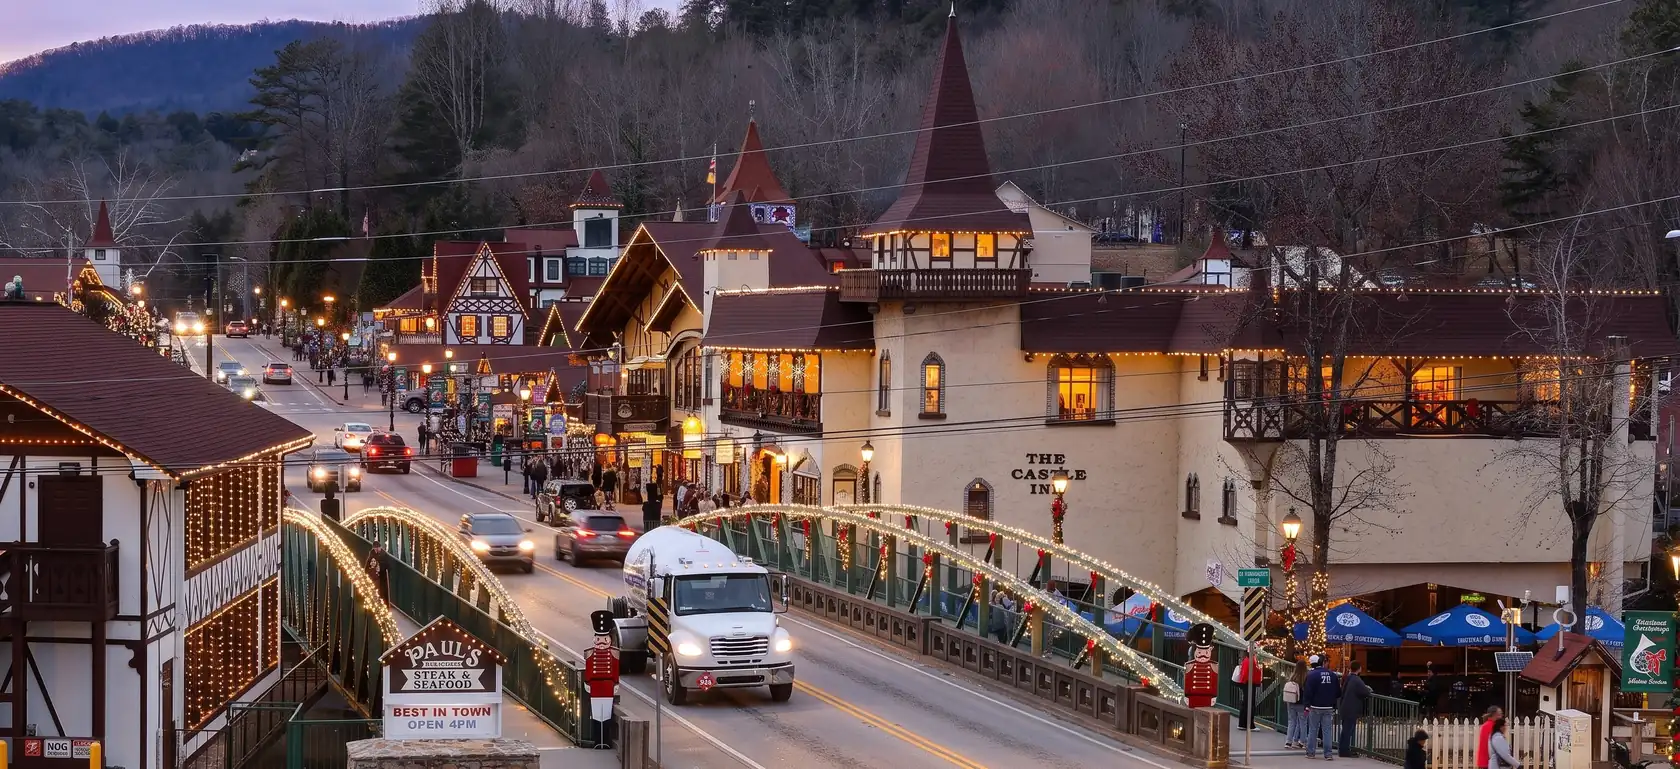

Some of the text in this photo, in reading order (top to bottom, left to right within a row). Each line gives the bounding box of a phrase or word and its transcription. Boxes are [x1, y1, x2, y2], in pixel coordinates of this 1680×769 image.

[1026, 453, 1066, 464] THE
[404, 640, 482, 668] PAUL'S
[413, 671, 471, 680] STEAK &
[413, 680, 472, 689] SEAFOOD
[393, 707, 491, 717] BEST IN TOWN
[408, 719, 477, 730] OPEN 4PM
[47, 742, 68, 751] NOG
